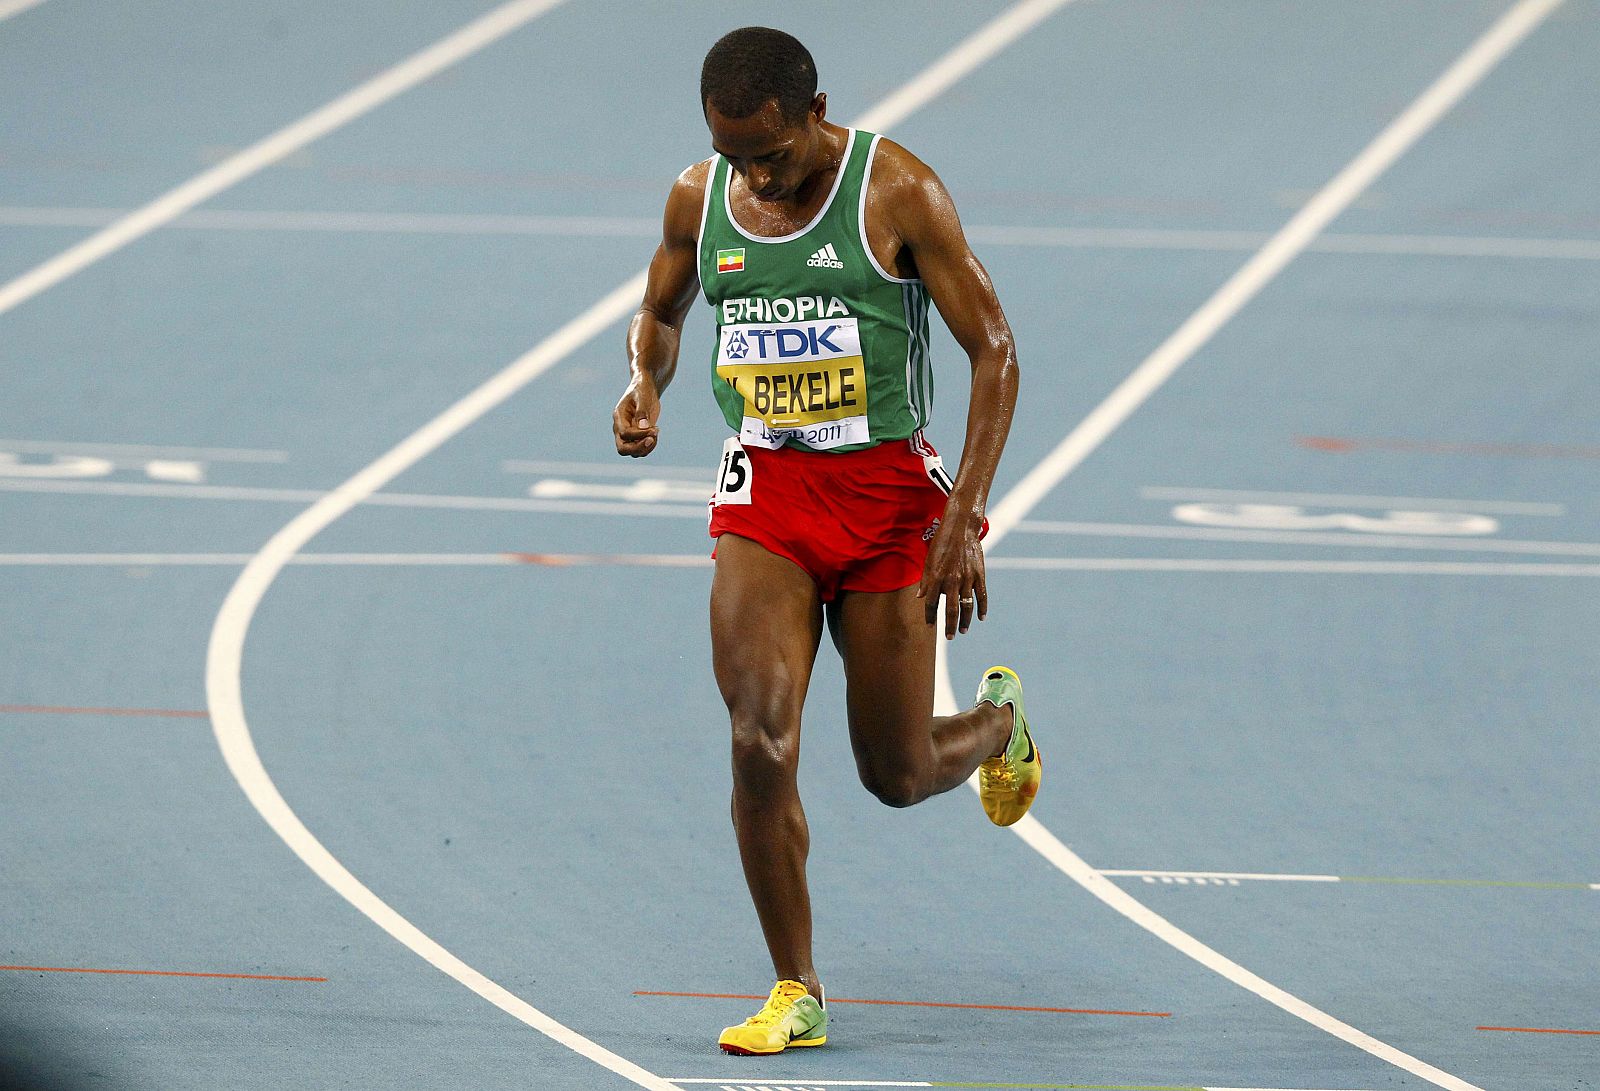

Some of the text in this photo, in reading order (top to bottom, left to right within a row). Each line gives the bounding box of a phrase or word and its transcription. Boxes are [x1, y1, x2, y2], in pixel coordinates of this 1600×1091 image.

[806, 257, 844, 269] adidas
[722, 296, 850, 323] ETHIOPIA
[748, 325, 844, 359] TDK
[754, 368, 857, 416] BEKELE
[807, 425, 841, 443] 2011
[720, 450, 746, 493] 15
[929, 467, 955, 495] 1
